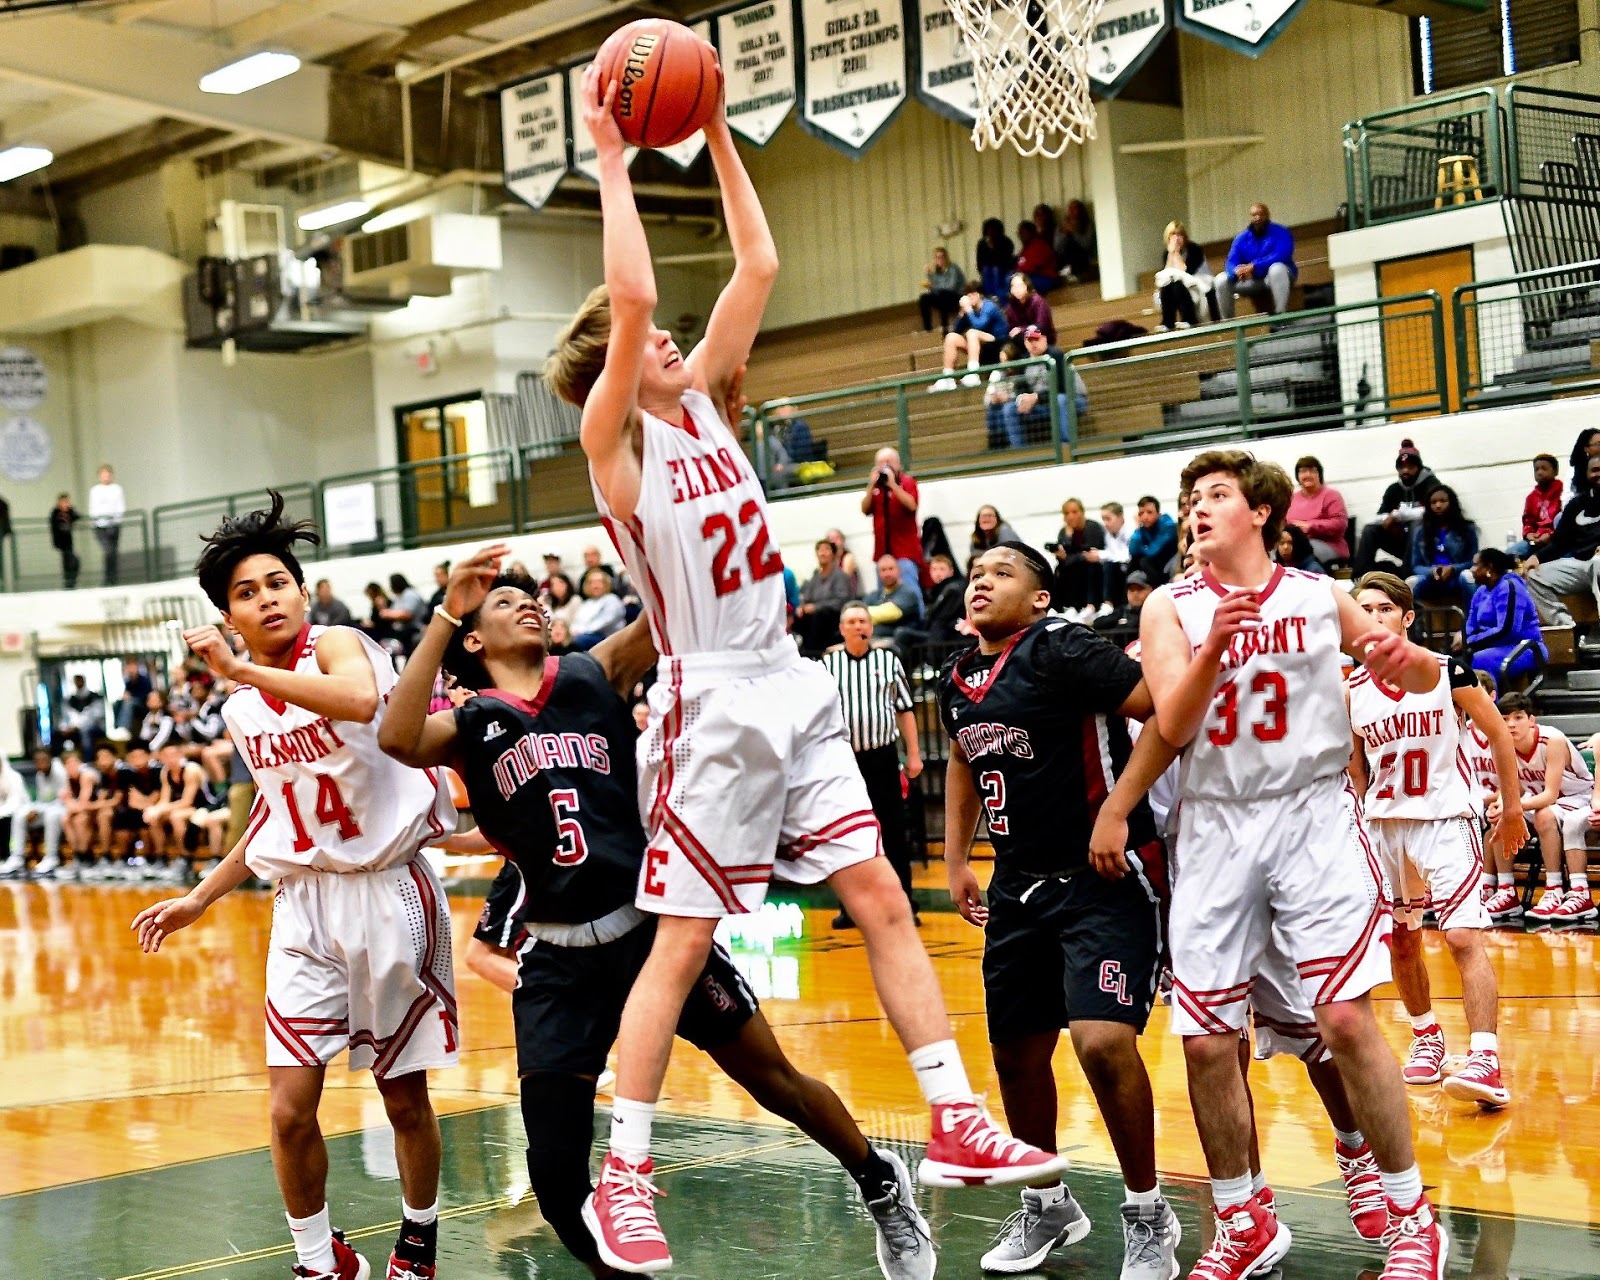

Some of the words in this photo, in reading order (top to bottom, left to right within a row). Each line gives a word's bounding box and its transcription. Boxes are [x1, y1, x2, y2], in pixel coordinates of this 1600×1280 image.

[810, 38, 846, 62] STATE
[850, 23, 899, 51] CHAMPS
[825, 13, 860, 37] GIRLS
[864, 8, 880, 27] 2A
[1092, 7, 1160, 44] ETBALL
[619, 33, 657, 118] Wilson
[812, 79, 901, 115] BASKETBALL
[701, 499, 785, 598] 22
[1208, 671, 1289, 748] 33
[1361, 709, 1444, 748] ELKMONT
[492, 732, 611, 801] INDIANS
[281, 772, 363, 854] 14
[548, 788, 589, 867] 5
[980, 770, 1009, 836] 2
[644, 848, 668, 897] E
[1099, 960, 1133, 1005] EL
